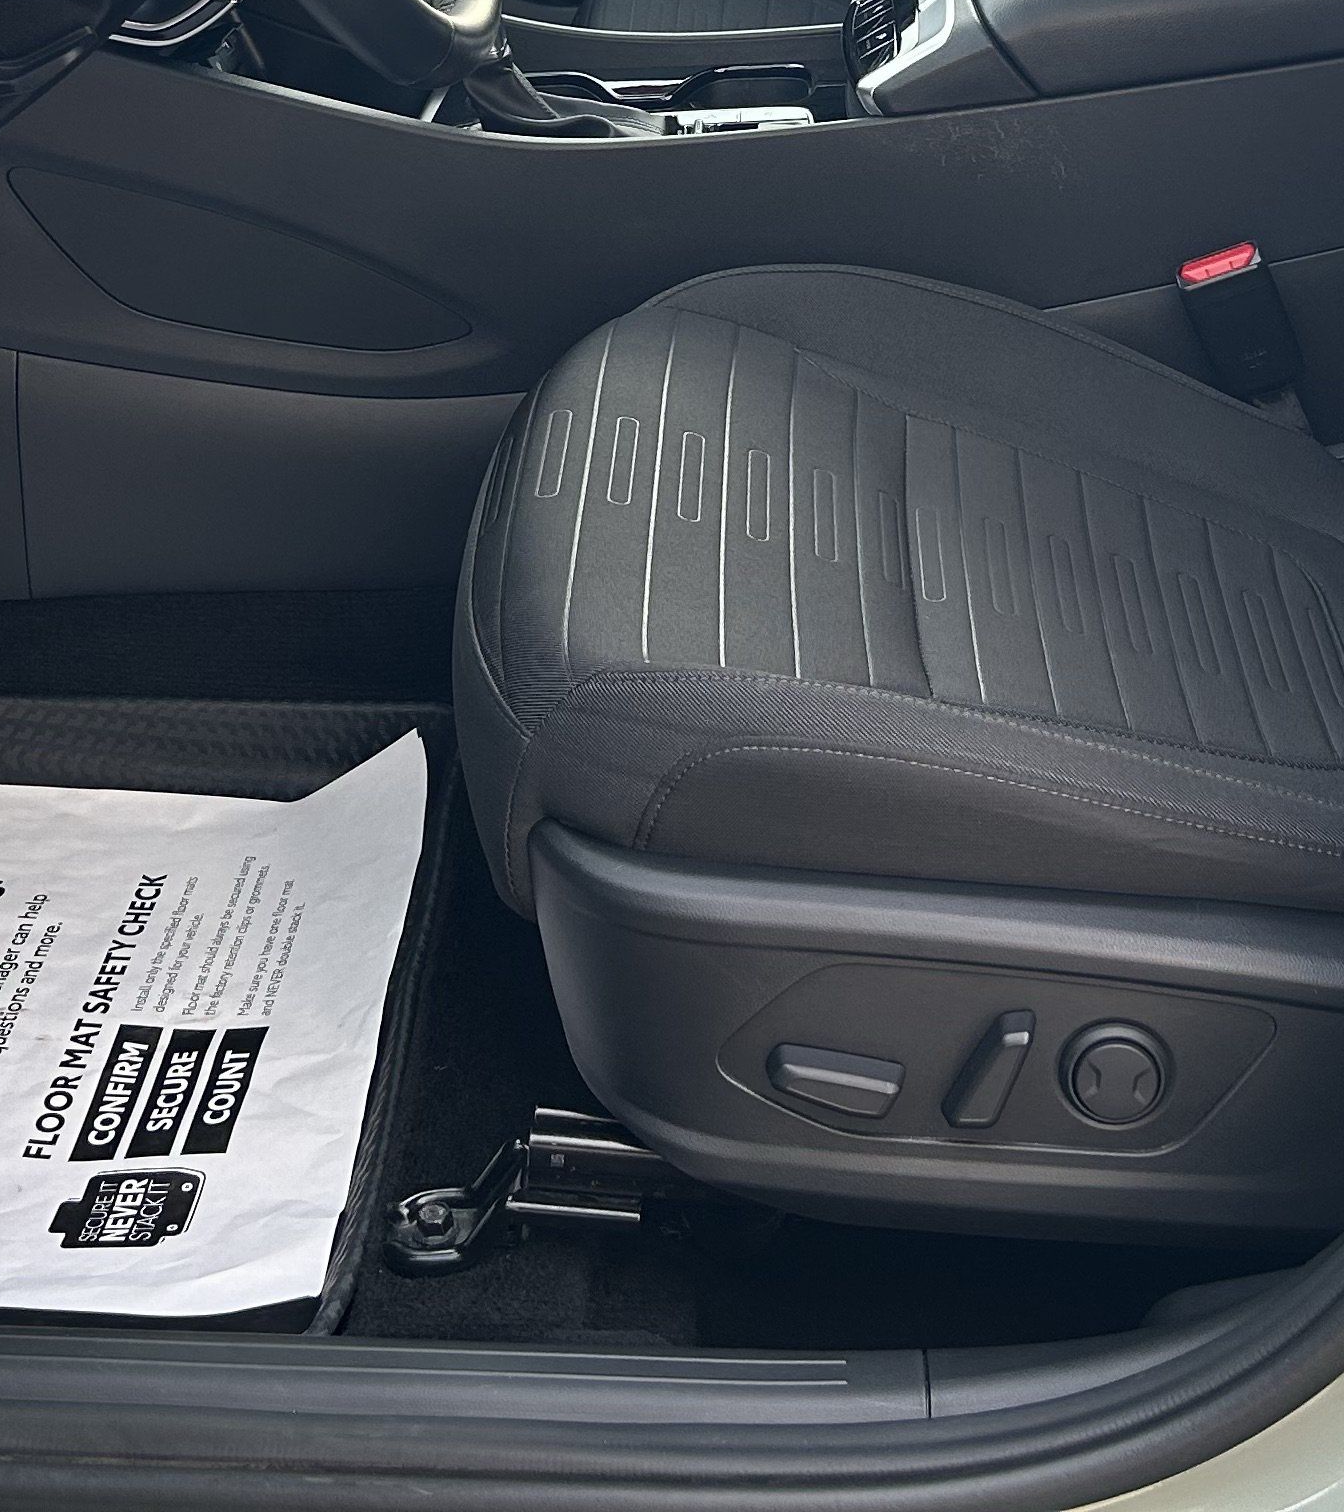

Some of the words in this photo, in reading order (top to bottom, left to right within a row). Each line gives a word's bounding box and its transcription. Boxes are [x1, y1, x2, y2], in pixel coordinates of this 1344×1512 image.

[17, 893, 51, 920] help
[172, 897, 190, 916] floor
[272, 897, 289, 917] floor
[11, 923, 34, 946] can
[269, 918, 282, 935] one
[20, 960, 44, 987] and
[33, 922, 63, 957] more.
[201, 945, 219, 974] should
[220, 908, 233, 920] be
[258, 936, 276, 956] have
[264, 969, 284, 998] NEVER
[278, 935, 296, 966] double
[288, 911, 303, 934] stack
[152, 950, 166, 966] the
[204, 999, 220, 1017] the
[213, 972, 234, 999] factory
[245, 905, 255, 915] or
[256, 957, 269, 974] you
[145, 966, 160, 985] only
[153, 972, 178, 1013] designed
[168, 959, 184, 971] for
[178, 941, 192, 959] your
[249, 973, 264, 991] sure
[130, 983, 153, 1011] Install
[237, 991, 256, 1016] Make
[22, 1074, 83, 1159] FLOOR
[58, 1018, 103, 1069] MAT
[82, 939, 136, 1014] SAFETY
[117, 874, 169, 938] CHECK
[87, 1041, 150, 1145] CONFIRM
[146, 1050, 199, 1131] SECURE
[202, 1049, 251, 1125] COUNT
[147, 1178, 171, 1194] IT
[78, 1194, 116, 1242] SECURE
[99, 1180, 119, 1193] IT
[98, 1178, 150, 1243] NEVER
[128, 1195, 168, 1242] STACK
